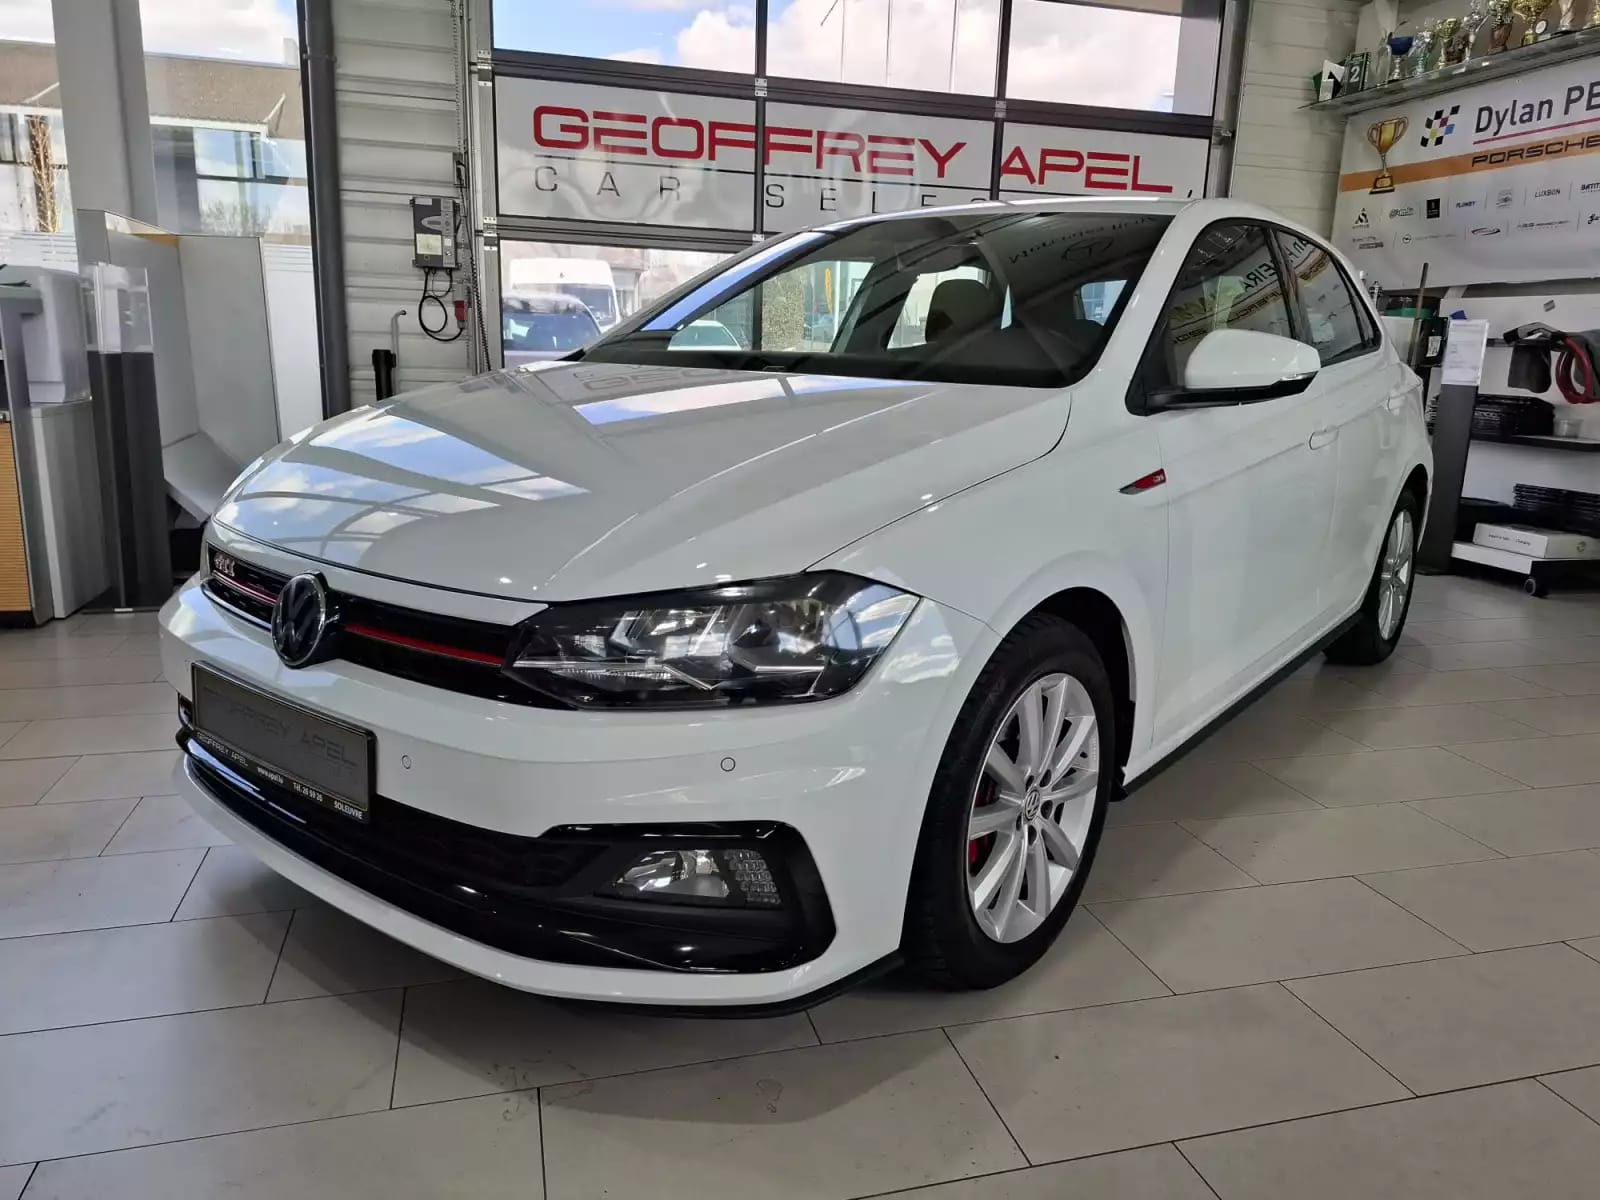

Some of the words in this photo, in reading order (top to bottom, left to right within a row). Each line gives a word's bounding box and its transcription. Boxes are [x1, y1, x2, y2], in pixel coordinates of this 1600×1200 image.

[1349, 65, 1360, 83] 2
[1475, 98, 1554, 136] Dylan
[533, 105, 967, 178] GEOFFREY
[1001, 145, 1173, 193] APEL
[1472, 134, 1600, 167] PORSCHE
[534, 166, 681, 201] CAR
